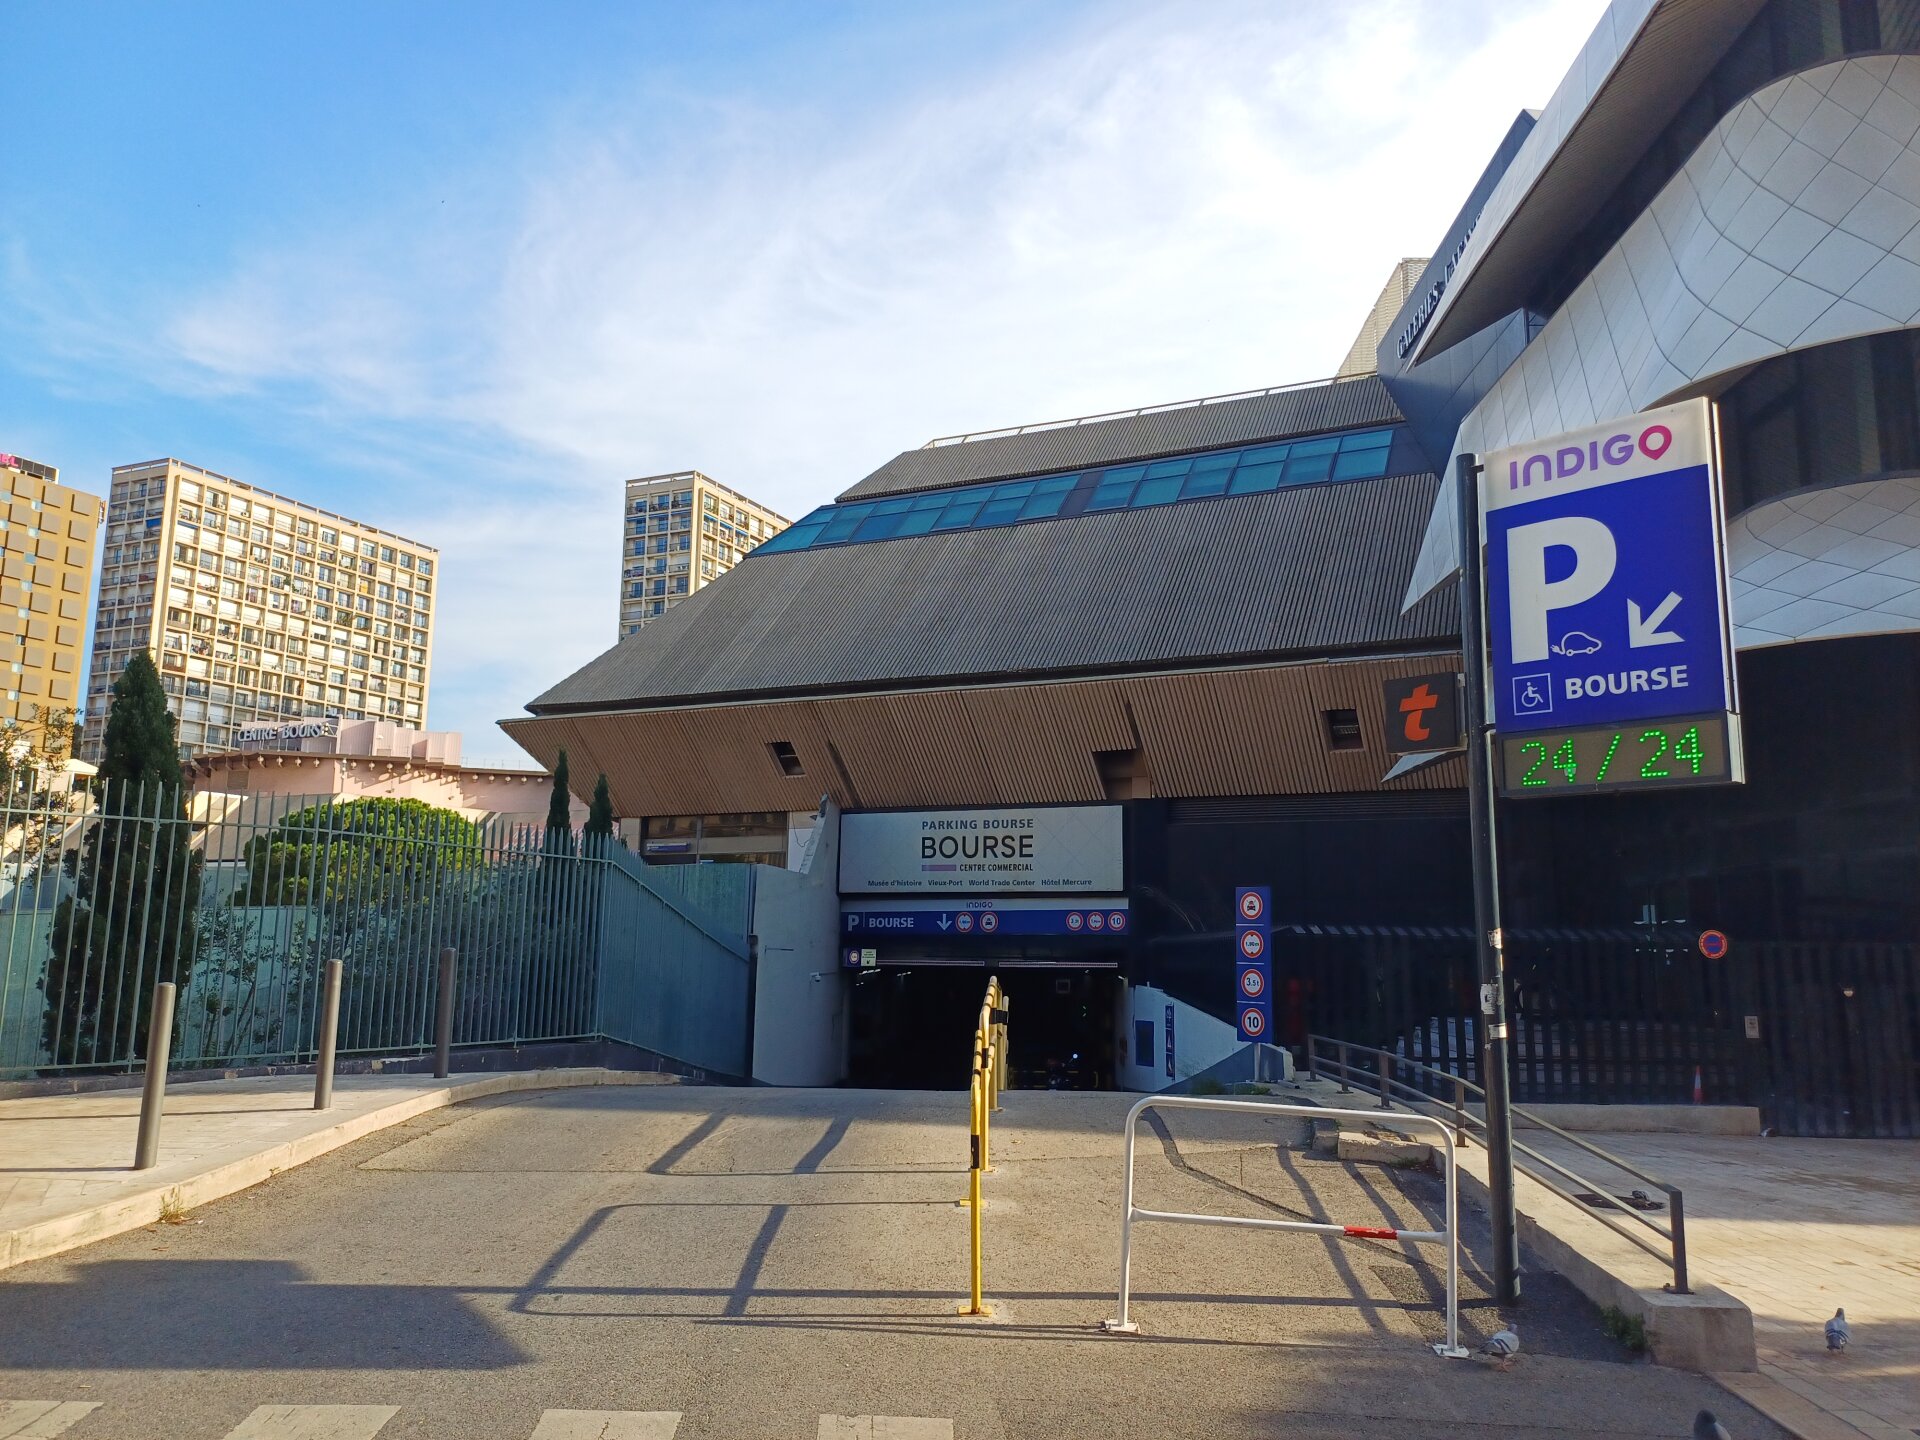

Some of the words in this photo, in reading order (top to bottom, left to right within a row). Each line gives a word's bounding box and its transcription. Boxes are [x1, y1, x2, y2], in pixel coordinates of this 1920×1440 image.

[1396, 281, 1441, 360] GALERIES
[1506, 516, 1617, 664] P
[1565, 665, 1689, 700] BOURSE
[237, 726, 277, 742] CENTRE
[1521, 738, 1577, 786] 24
[1638, 726, 1704, 777] 24
[922, 820, 978, 831] PARKING
[983, 818, 1034, 829] BOURSE
[921, 834, 1034, 859] BOURSE
[959, 864, 986, 872] CENTRE
[988, 863, 1033, 872] COMMERCIAL
[890, 879, 922, 887] d'histoire
[1041, 878, 1060, 886] Hôtel
[1062, 878, 1092, 886] Mercure
[848, 914, 859, 931] P
[869, 916, 914, 928] BOURSE
[1111, 917, 1121, 925] 10
[1247, 1017, 1259, 1028] 10
